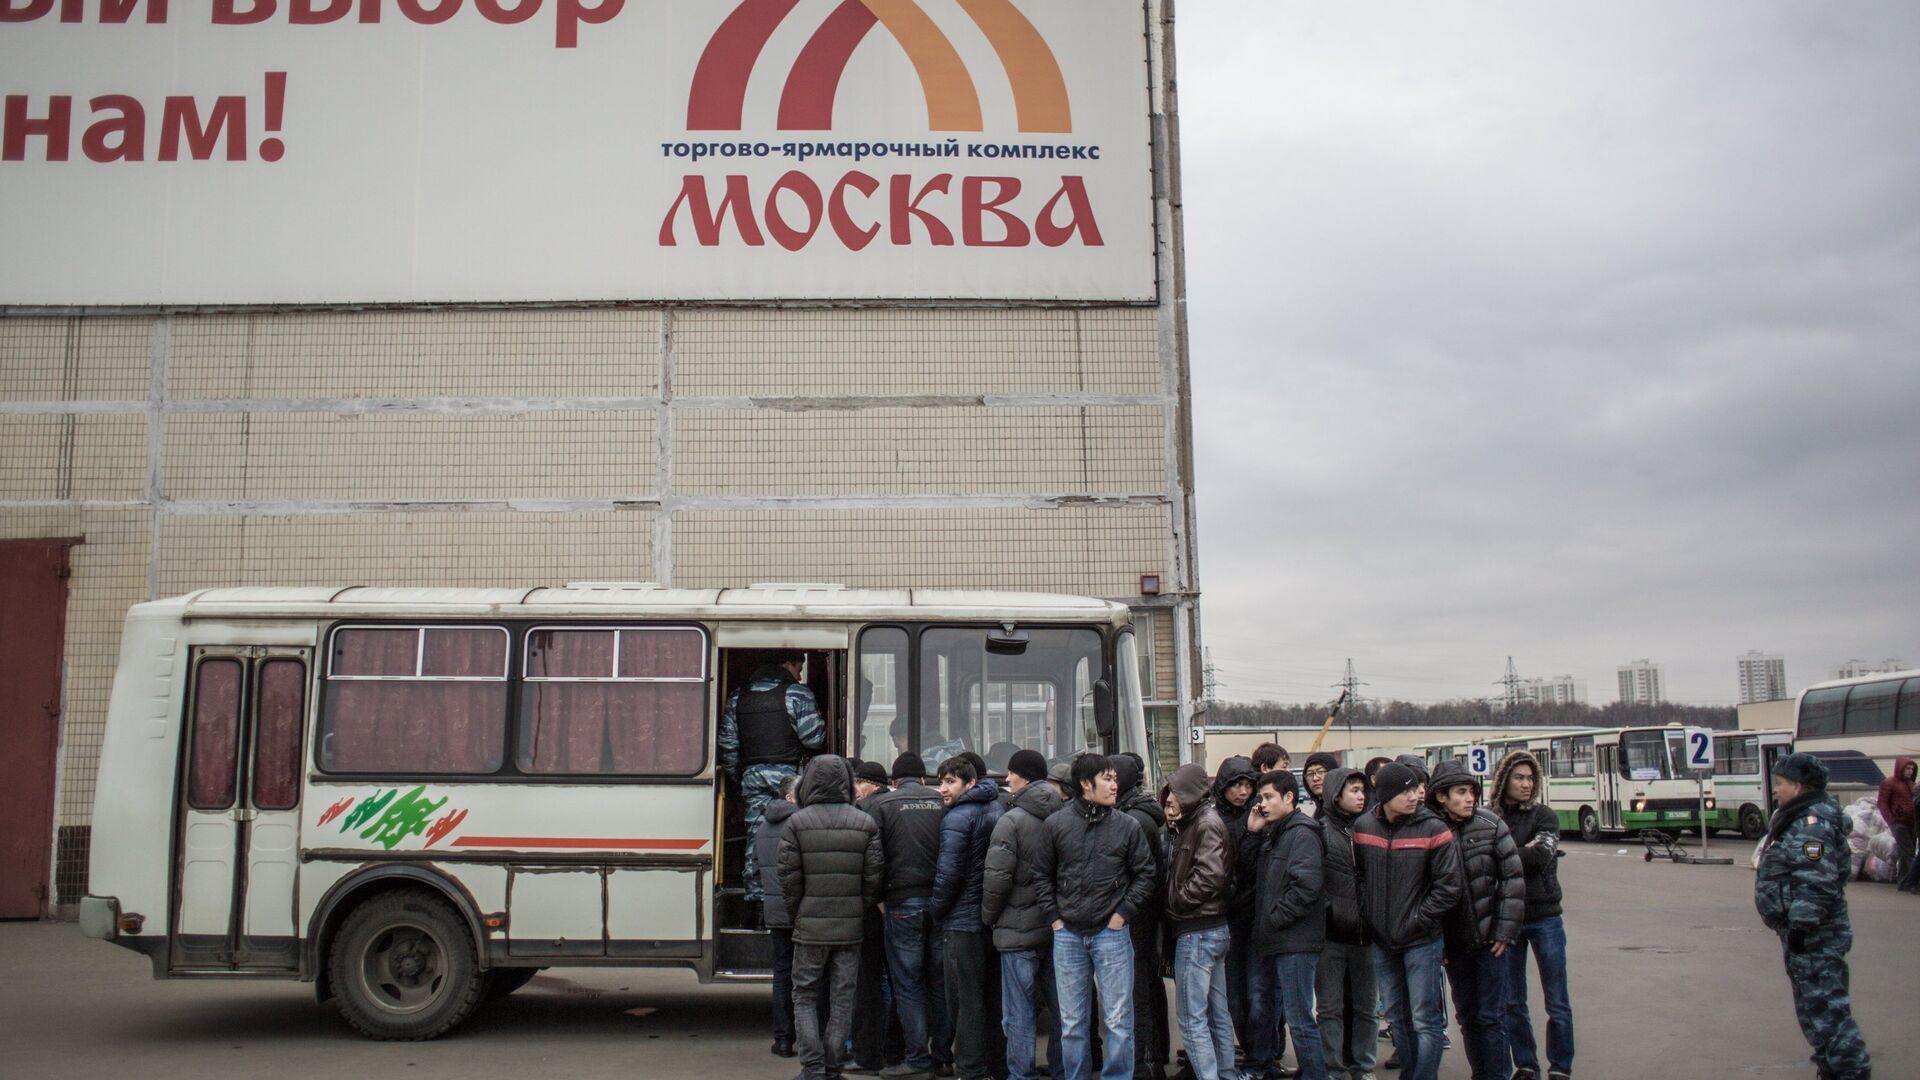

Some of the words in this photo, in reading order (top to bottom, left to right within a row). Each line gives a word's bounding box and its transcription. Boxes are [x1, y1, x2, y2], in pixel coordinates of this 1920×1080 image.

[3, 71, 288, 162] нам!
[661, 137, 960, 162] торгово-ярмарочный
[967, 141, 1100, 160] комплекс
[659, 170, 1105, 252] МОСКВА
[1192, 729, 1199, 740] 3
[1690, 732, 1710, 764] 2
[1472, 748, 1486, 772] 3
